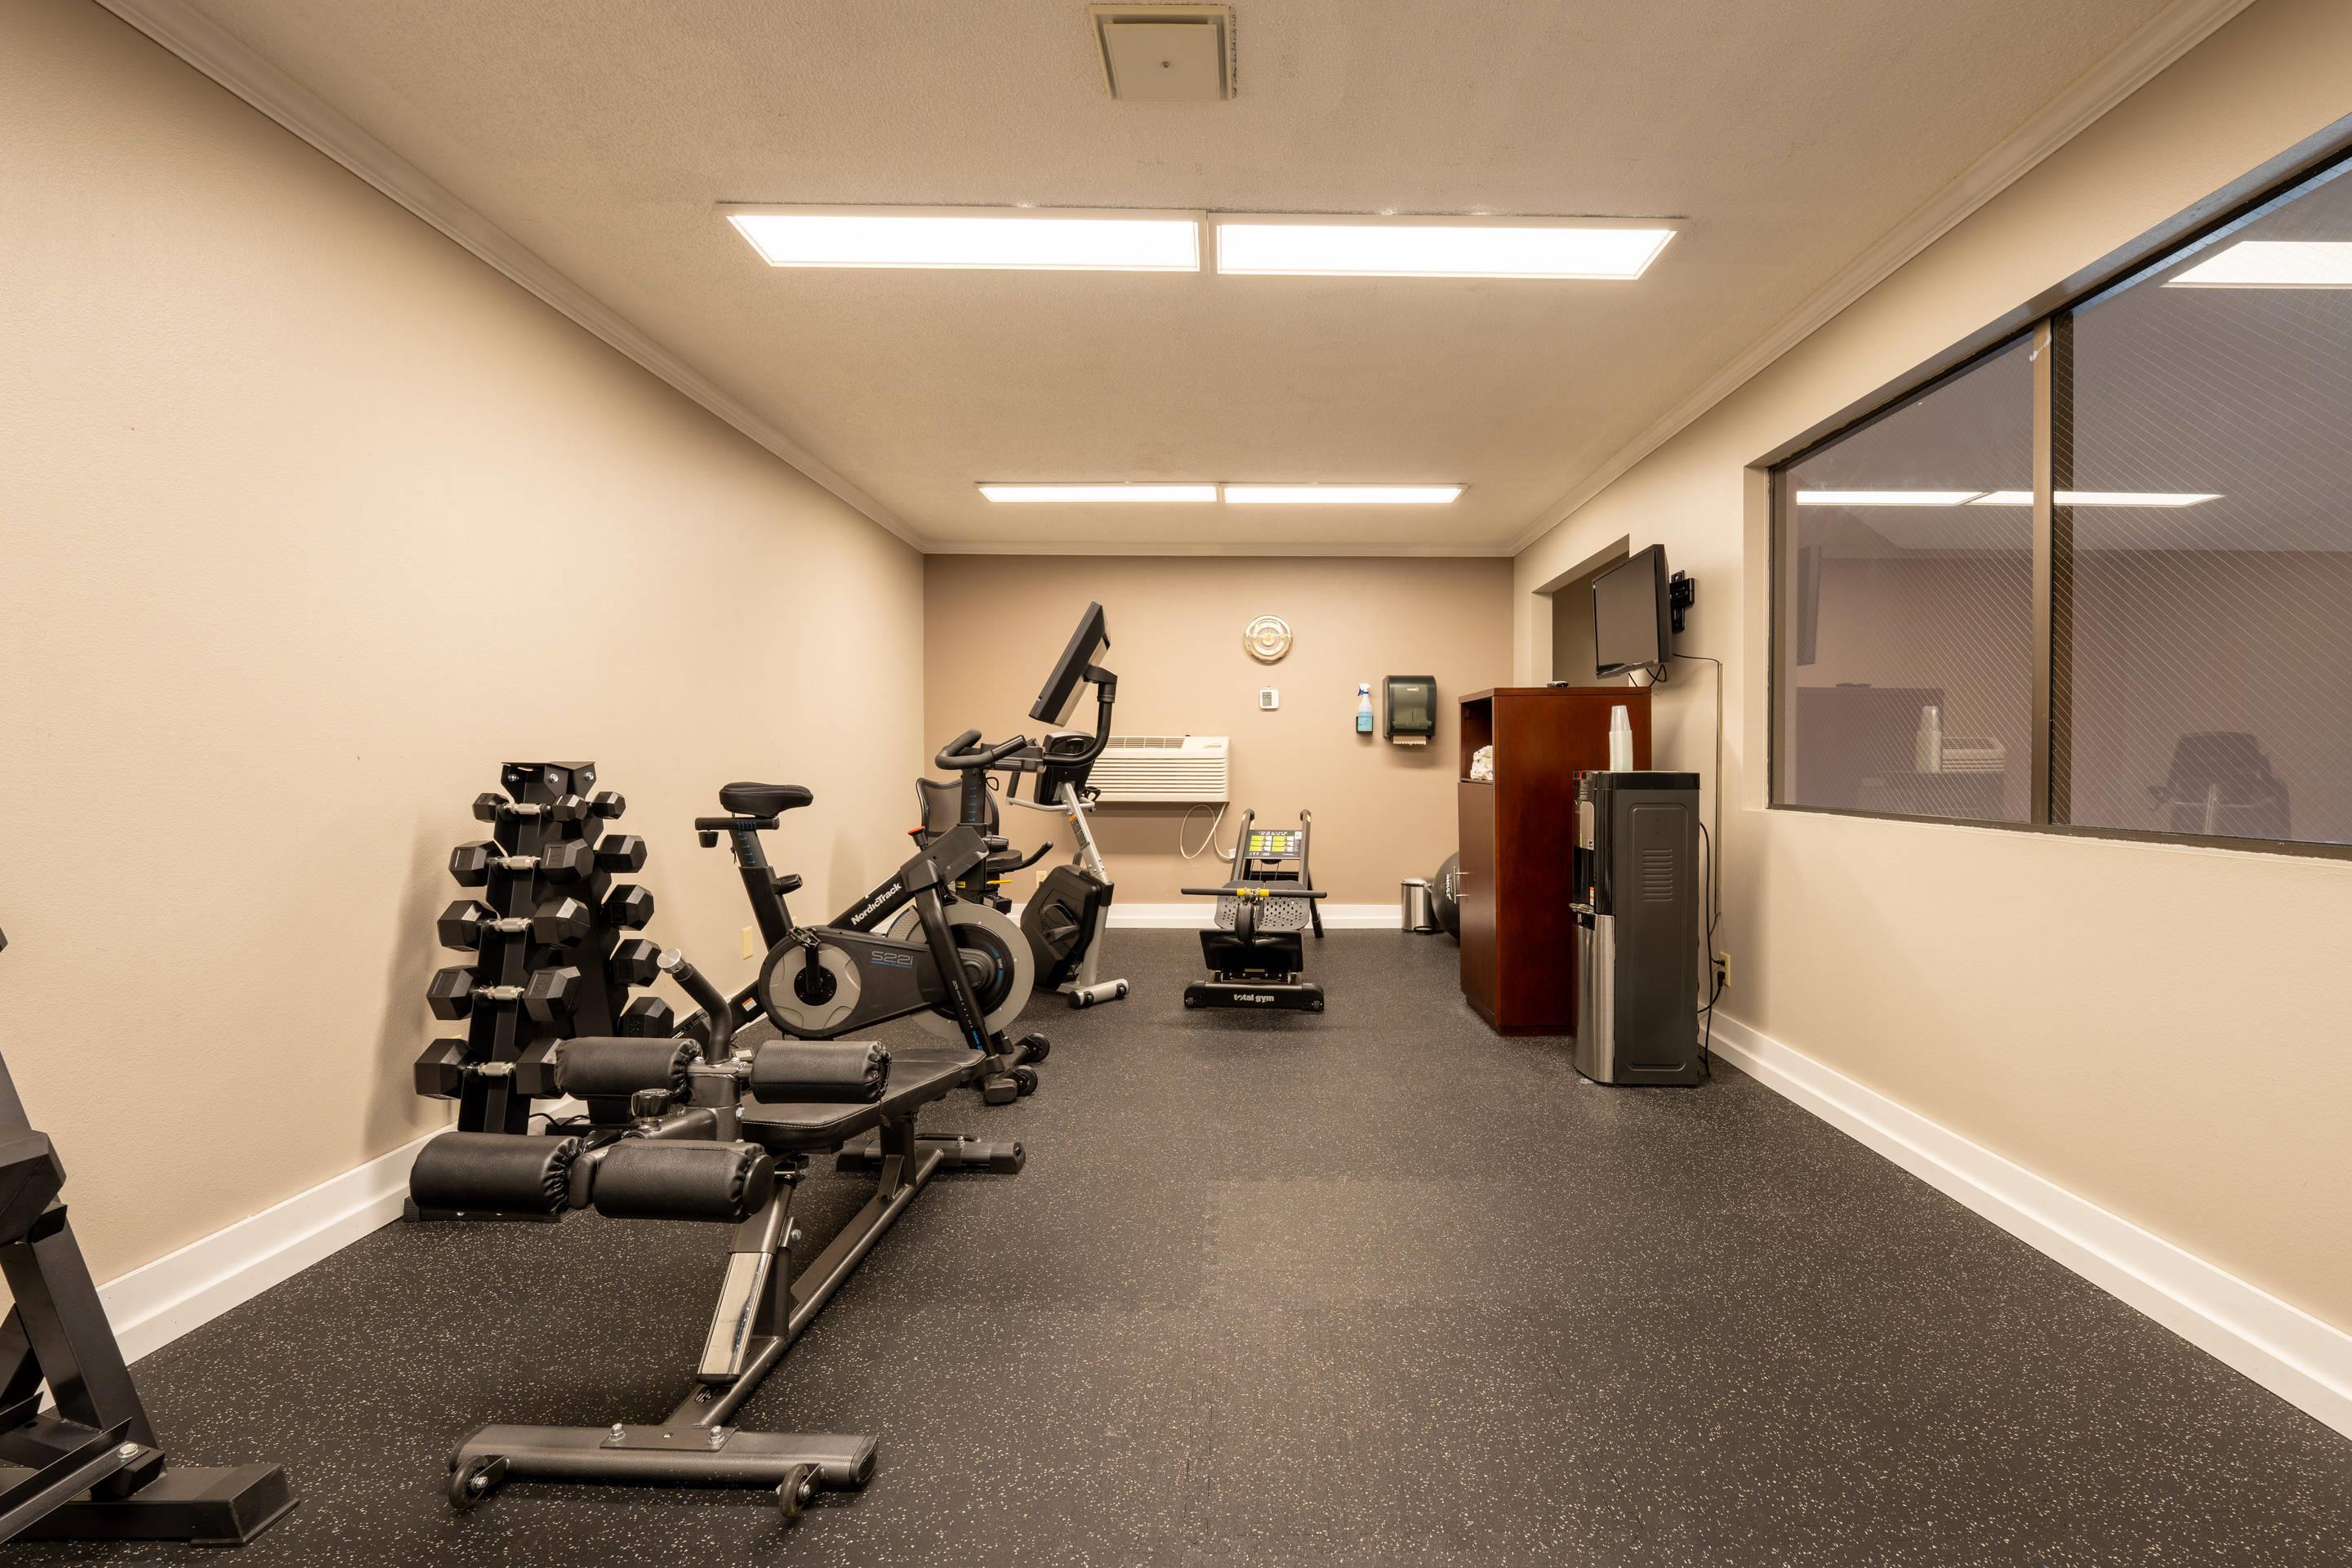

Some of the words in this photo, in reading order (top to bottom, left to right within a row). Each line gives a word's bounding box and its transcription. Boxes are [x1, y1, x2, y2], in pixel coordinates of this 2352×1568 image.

[851, 883, 902, 925] NordicTrack
[871, 951, 913, 965] S22i
[1255, 995, 1274, 1003] gym
